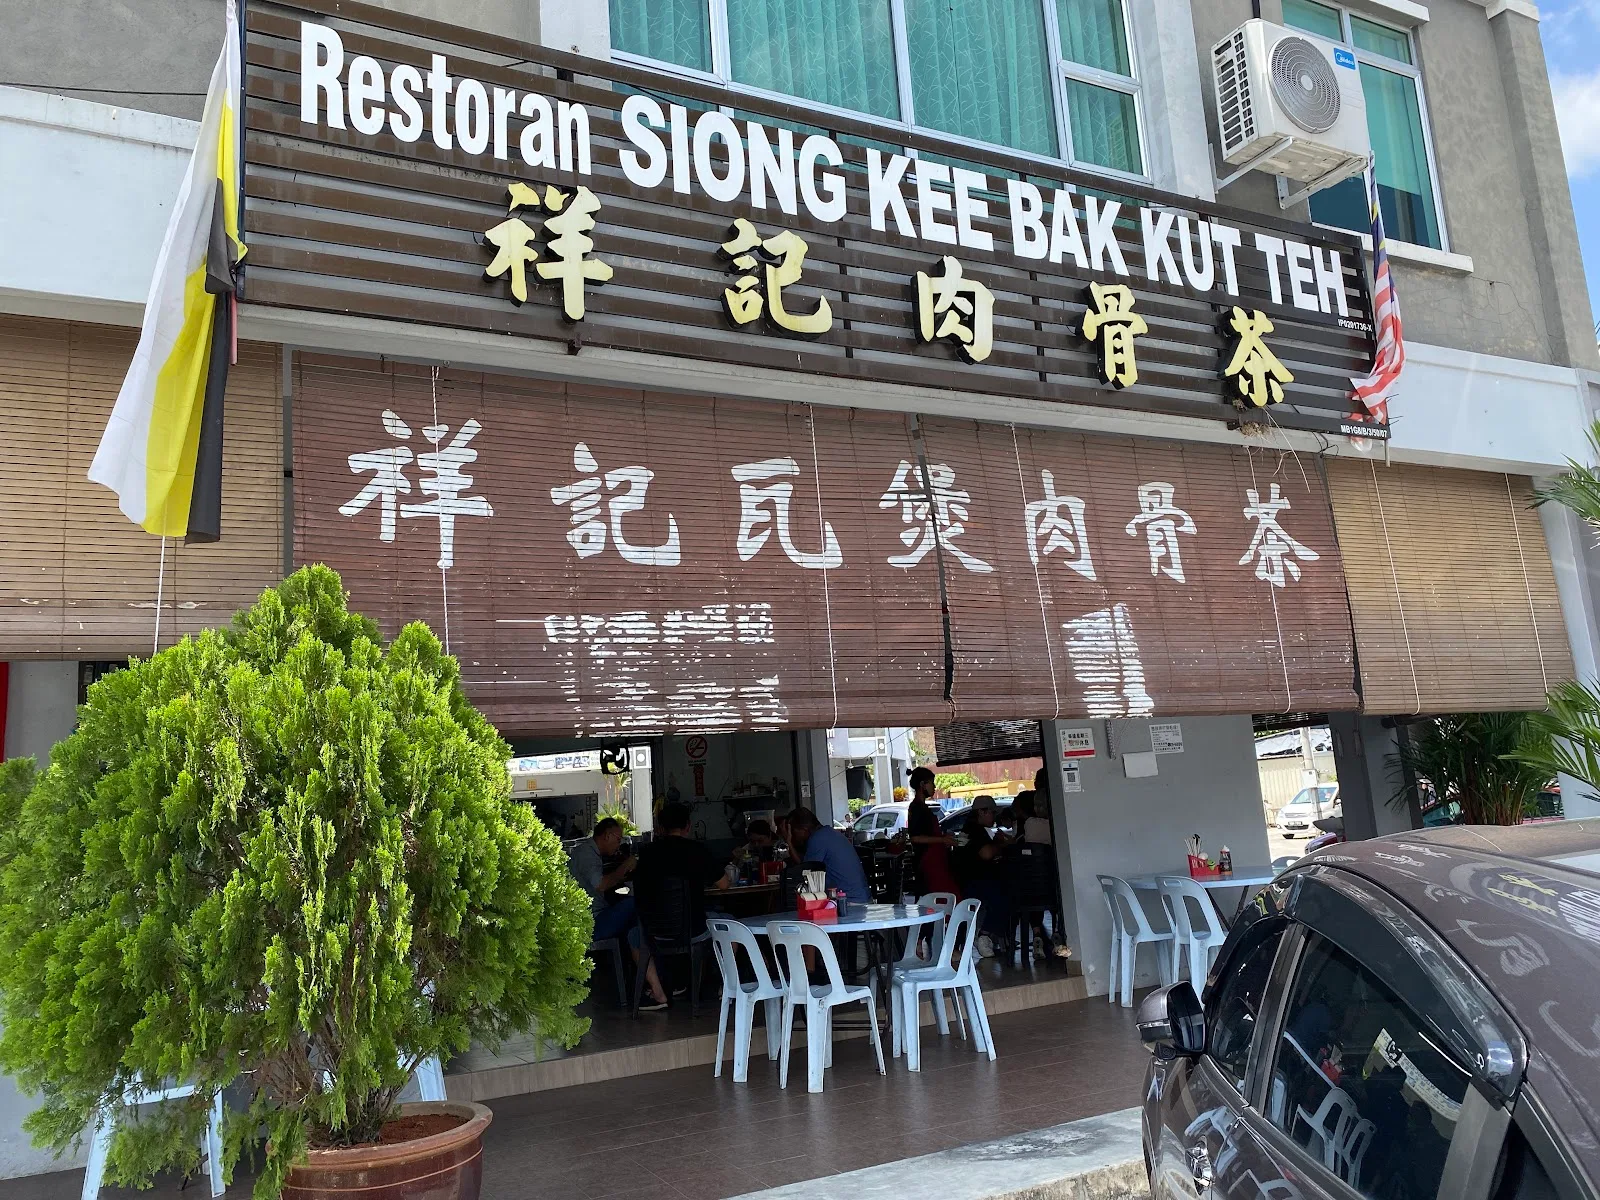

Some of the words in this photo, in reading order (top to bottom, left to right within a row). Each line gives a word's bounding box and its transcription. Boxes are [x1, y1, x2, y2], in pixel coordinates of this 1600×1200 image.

[301, 21, 592, 176] Restoran
[619, 96, 847, 222] SIONG
[867, 148, 995, 252] KEE
[1007, 179, 1130, 277] BAK
[1140, 207, 1242, 296] KUT
[1255, 233, 1349, 318] TEH
